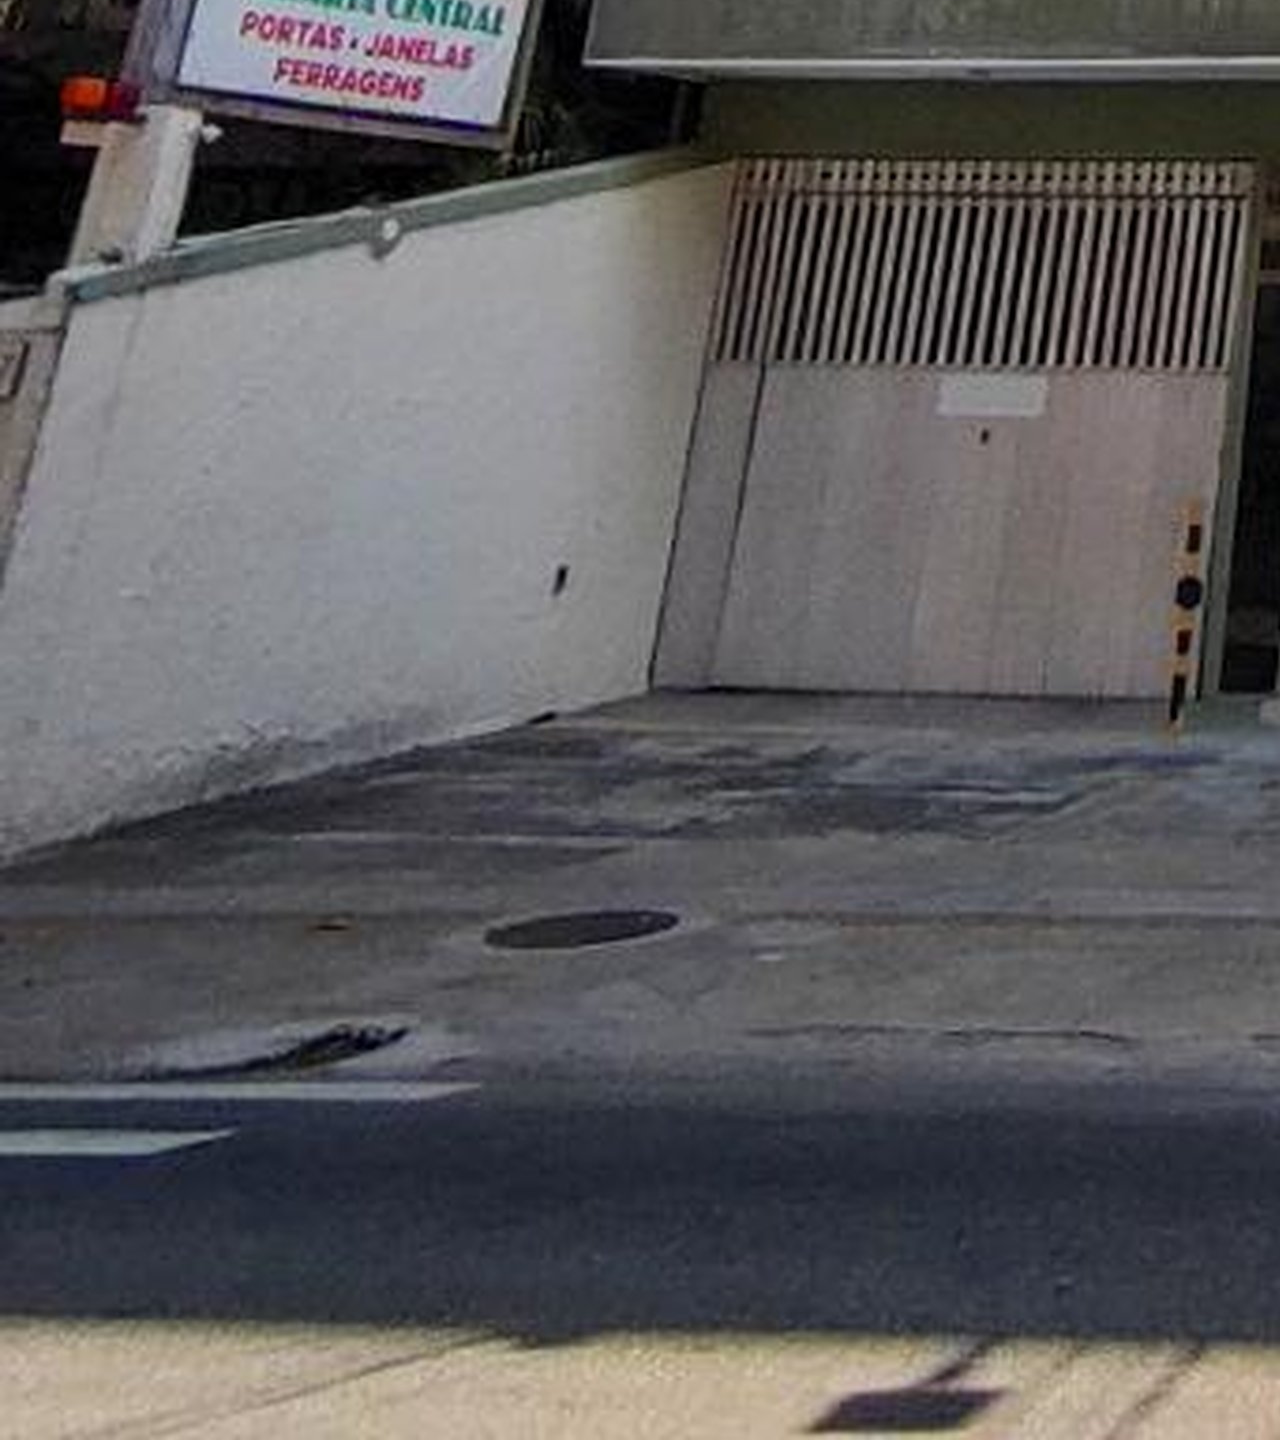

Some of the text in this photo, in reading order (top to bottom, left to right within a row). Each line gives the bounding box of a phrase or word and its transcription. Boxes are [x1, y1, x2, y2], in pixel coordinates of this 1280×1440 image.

[240, 11, 475, 71] PORTAS JANELAS
[273, 58, 425, 101] FERRAGENS
